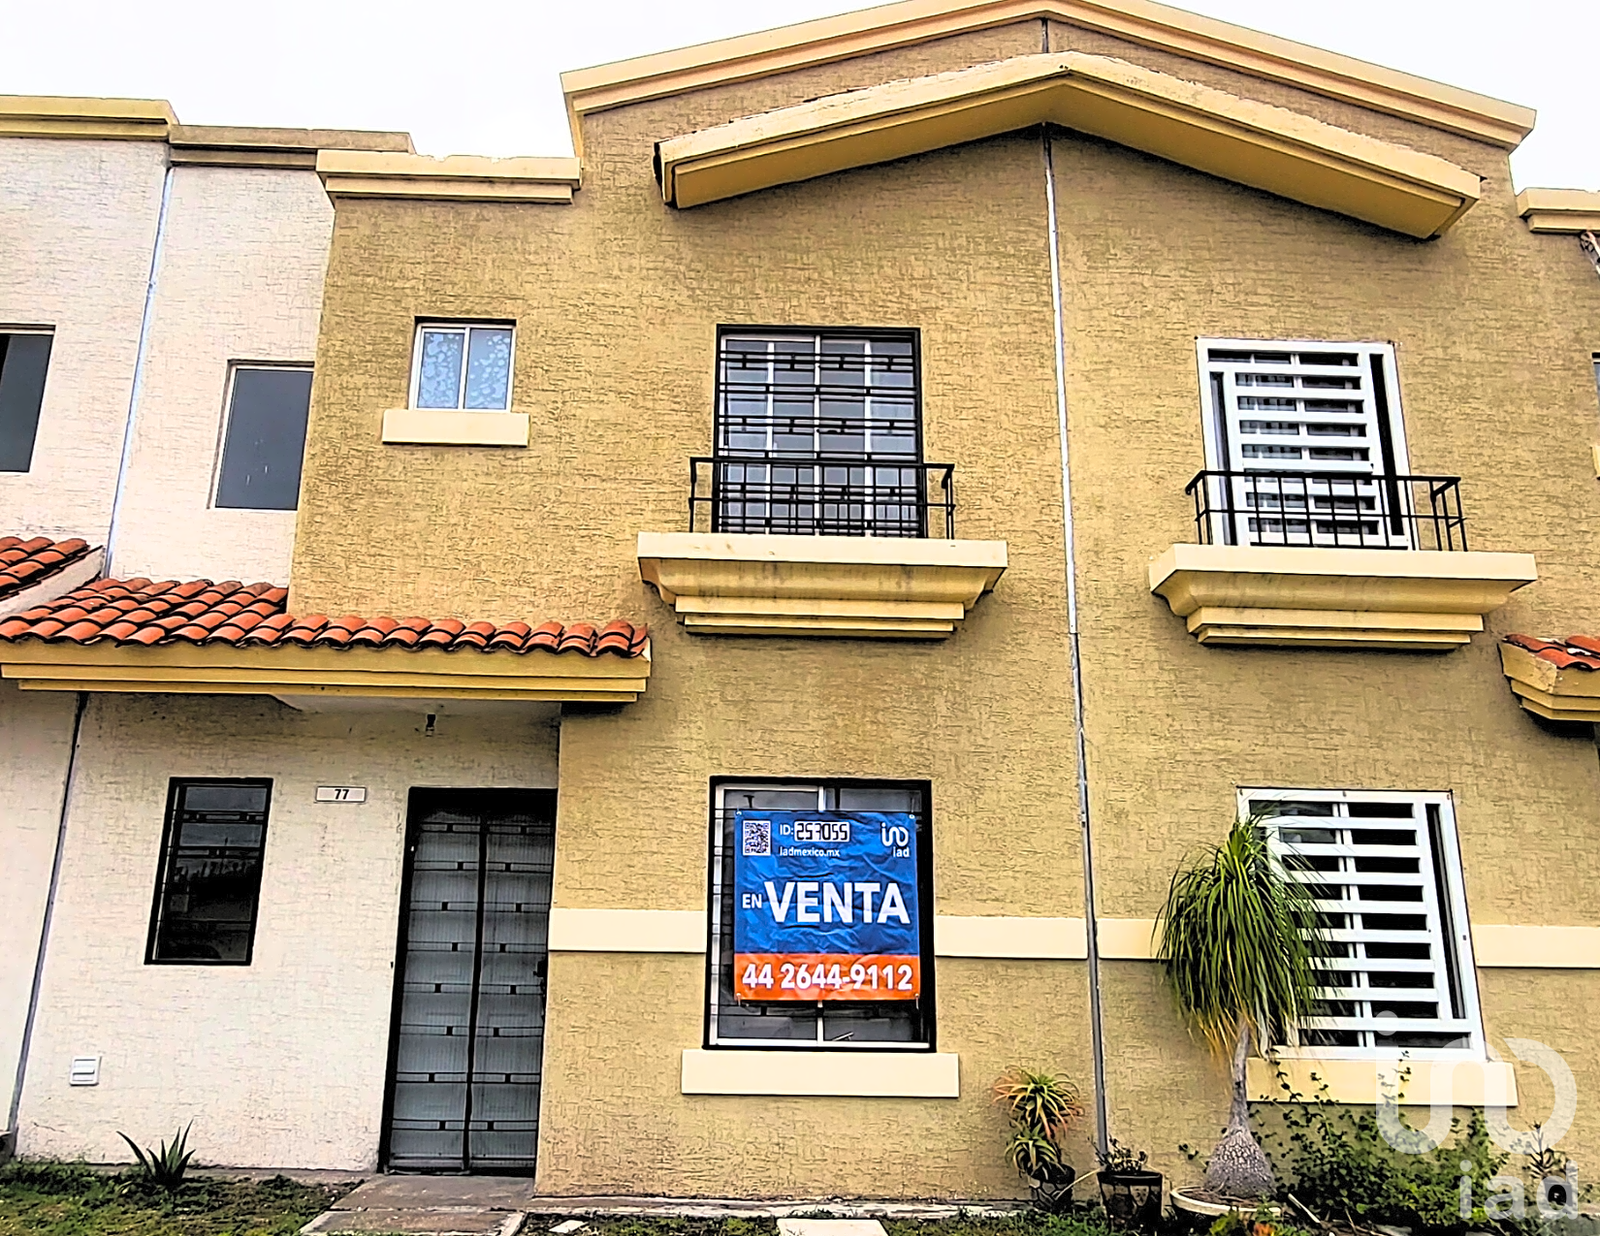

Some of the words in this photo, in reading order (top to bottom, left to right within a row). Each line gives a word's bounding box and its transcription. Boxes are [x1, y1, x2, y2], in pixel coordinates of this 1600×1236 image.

[334, 788, 350, 800] 77
[779, 824, 794, 836] ID:
[893, 847, 910, 858] iad
[742, 893, 763, 909] EN
[763, 881, 911, 924] VENTA
[742, 963, 774, 990] 44
[780, 963, 913, 991] 2644-9112
